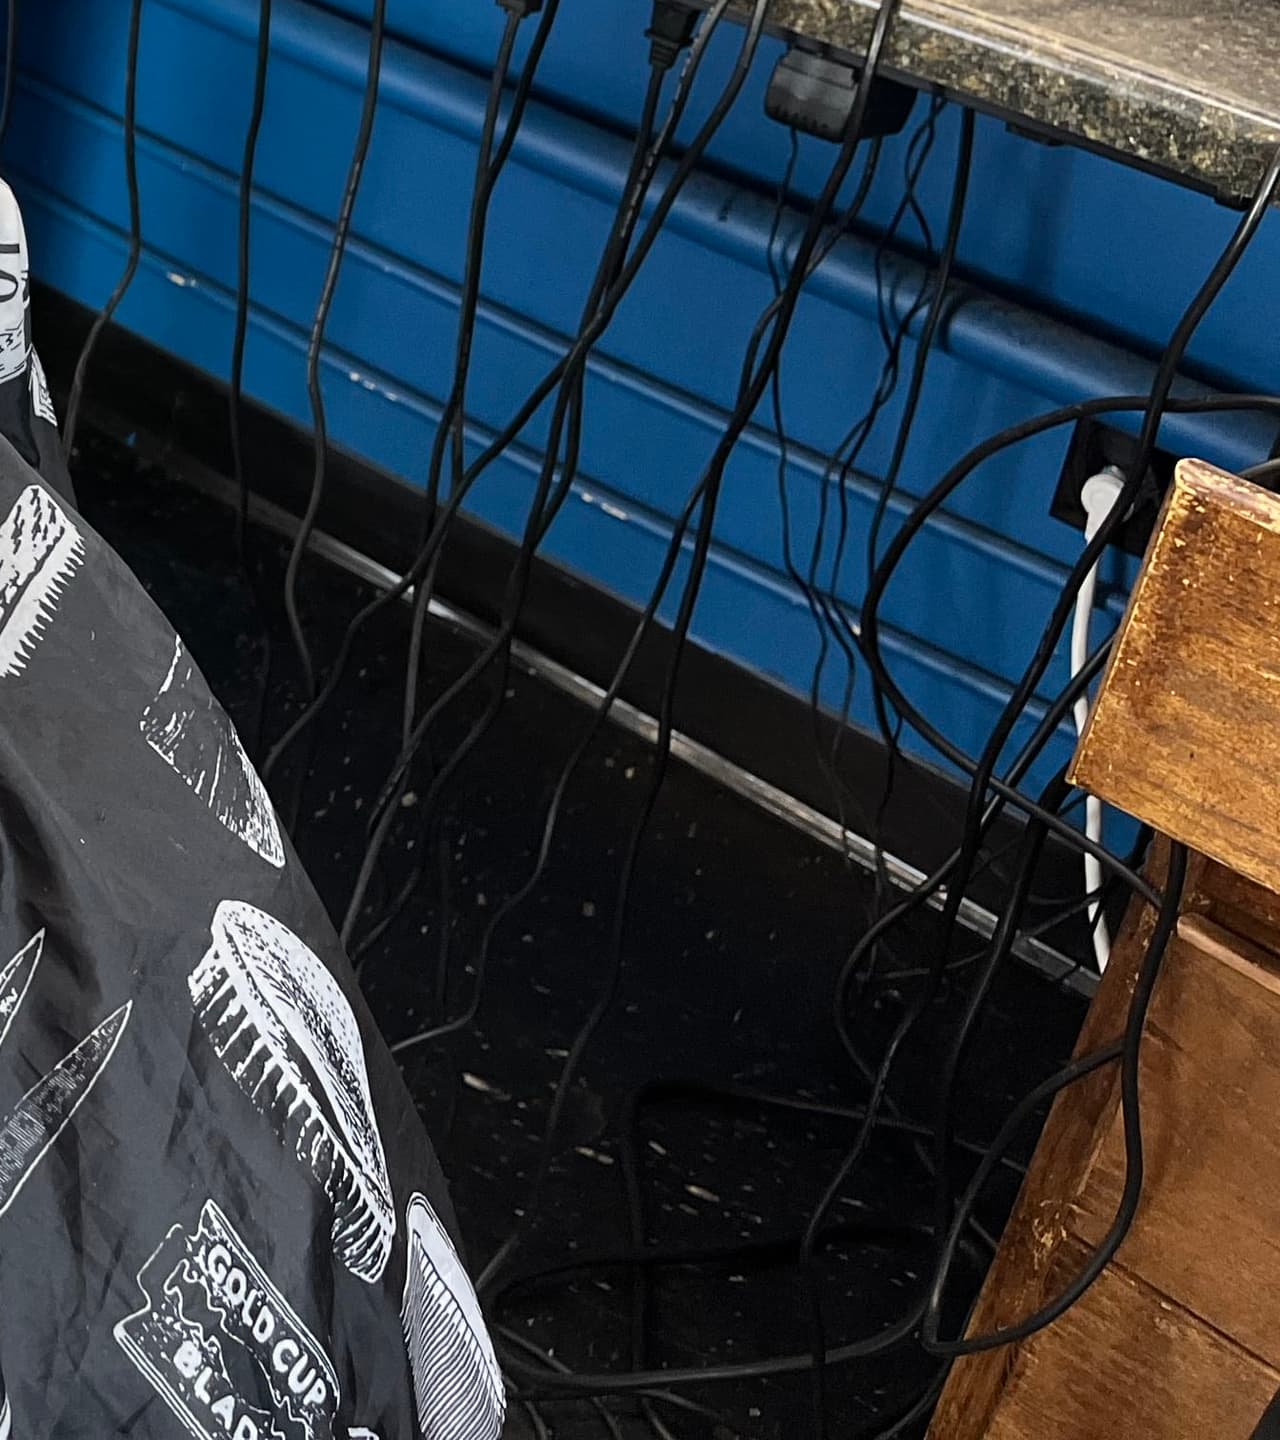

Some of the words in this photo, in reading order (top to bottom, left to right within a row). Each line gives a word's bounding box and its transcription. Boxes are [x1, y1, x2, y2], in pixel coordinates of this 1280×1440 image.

[173, 1339, 259, 1439] BLAD
[207, 1243, 275, 1344] GOLD
[272, 1338, 327, 1406] CUP
